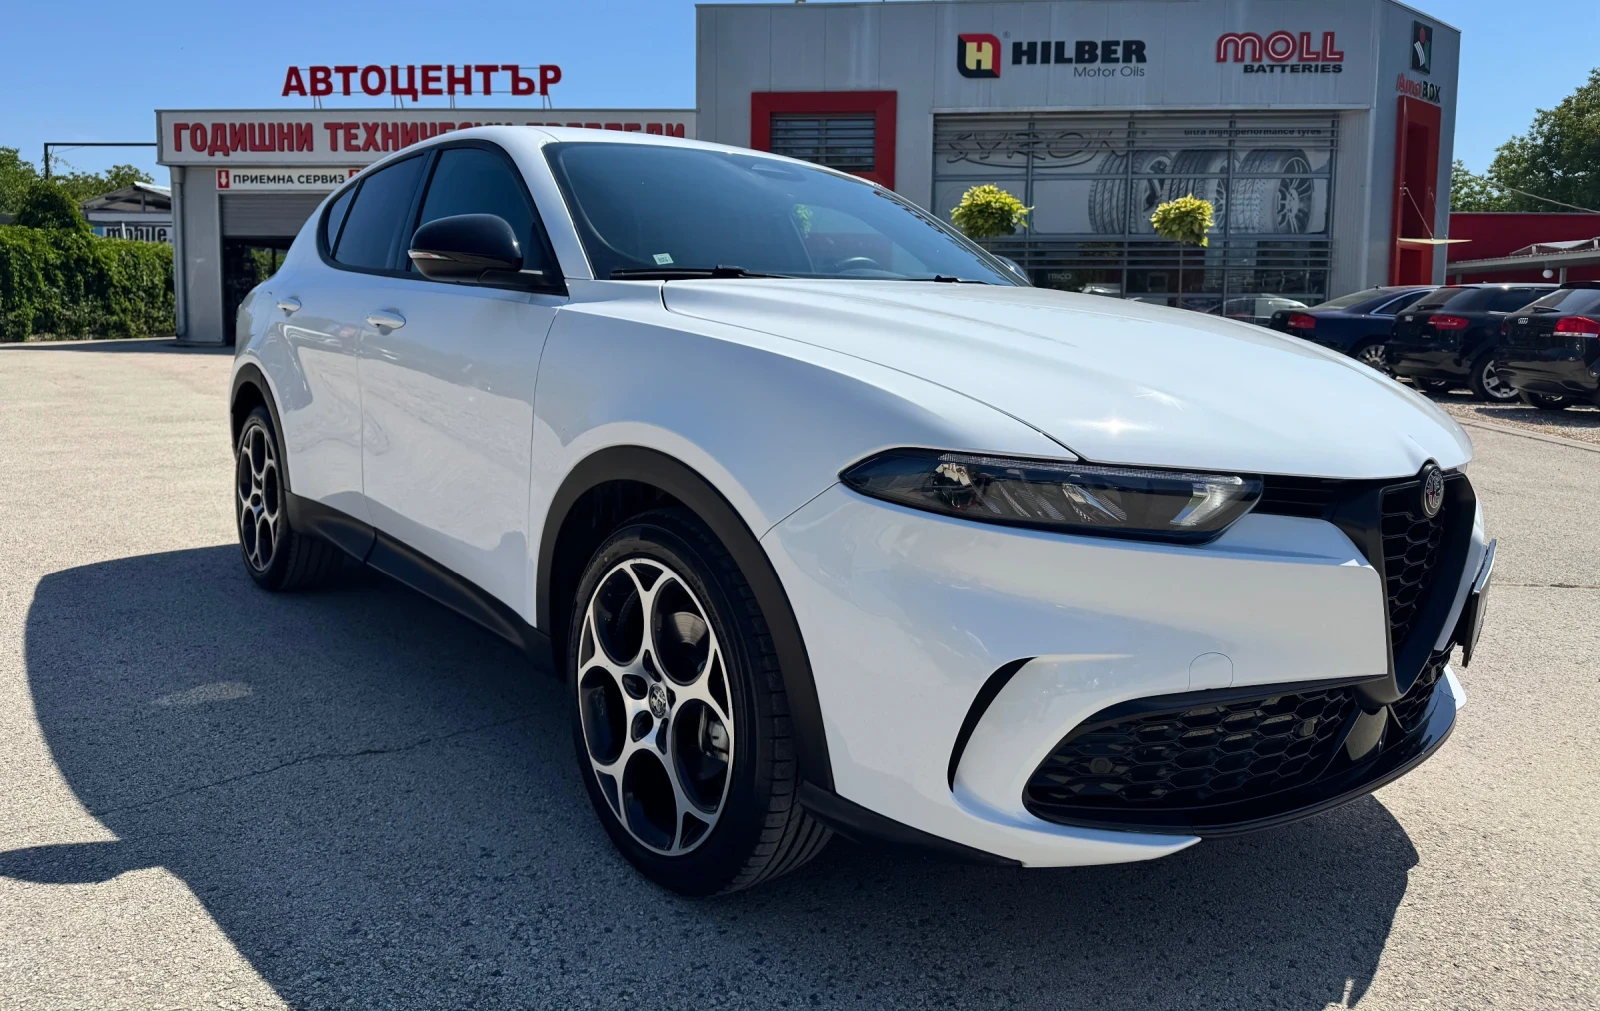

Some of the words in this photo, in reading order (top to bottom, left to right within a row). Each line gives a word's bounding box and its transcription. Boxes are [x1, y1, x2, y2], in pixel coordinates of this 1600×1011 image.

[1012, 40, 1147, 65] HILBER
[1073, 66, 1116, 78] Motor
[1120, 65, 1145, 77] Oils
[1243, 64, 1343, 73] BATTERIES
[281, 64, 562, 102] АВТОЦЕНТЪР
[173, 122, 313, 156] ГОДИШНИ
[233, 174, 294, 185] ПРИЕМНА
[297, 174, 345, 185] СЕРВИЗ
